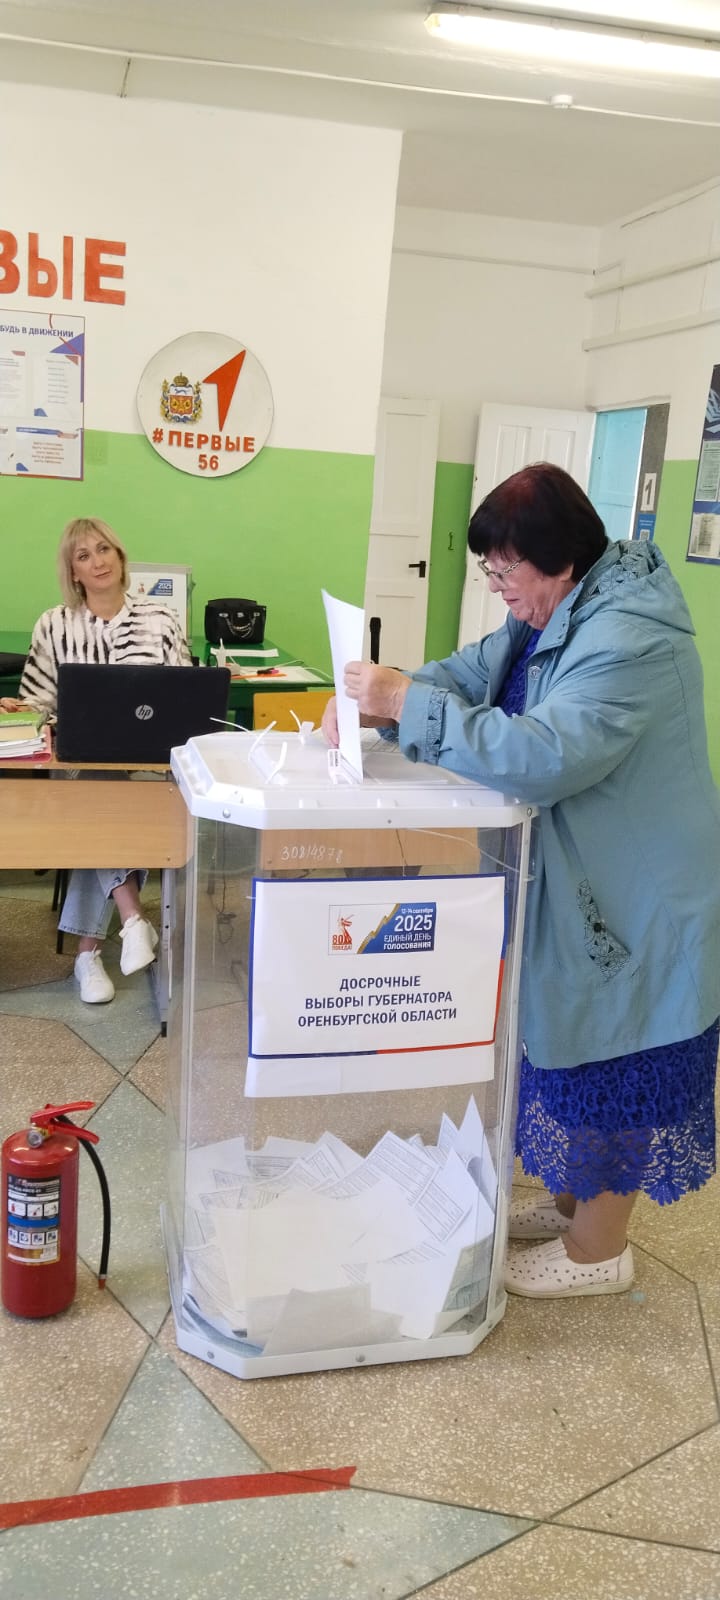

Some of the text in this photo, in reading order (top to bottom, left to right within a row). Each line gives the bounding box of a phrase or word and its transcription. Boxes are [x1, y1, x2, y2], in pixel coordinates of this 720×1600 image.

[21, 326, 27, 334] В
[28, 327, 74, 338] ДВИЖЕНИИ
[198, 454, 219, 471] 56
[644, 478, 653, 505] 1
[394, 915, 432, 932] 2025
[384, 933, 431, 942] ЕДИНЫЙ ДЕНЬ
[339, 976, 421, 992] ДОСРОЧНЫЕ
[304, 991, 453, 1010] ВЫБОРЫ ГУБЕРНАТОРА
[297, 1007, 458, 1028] ОРЕНБУРГСКОЙ ОБЛАСТИ
